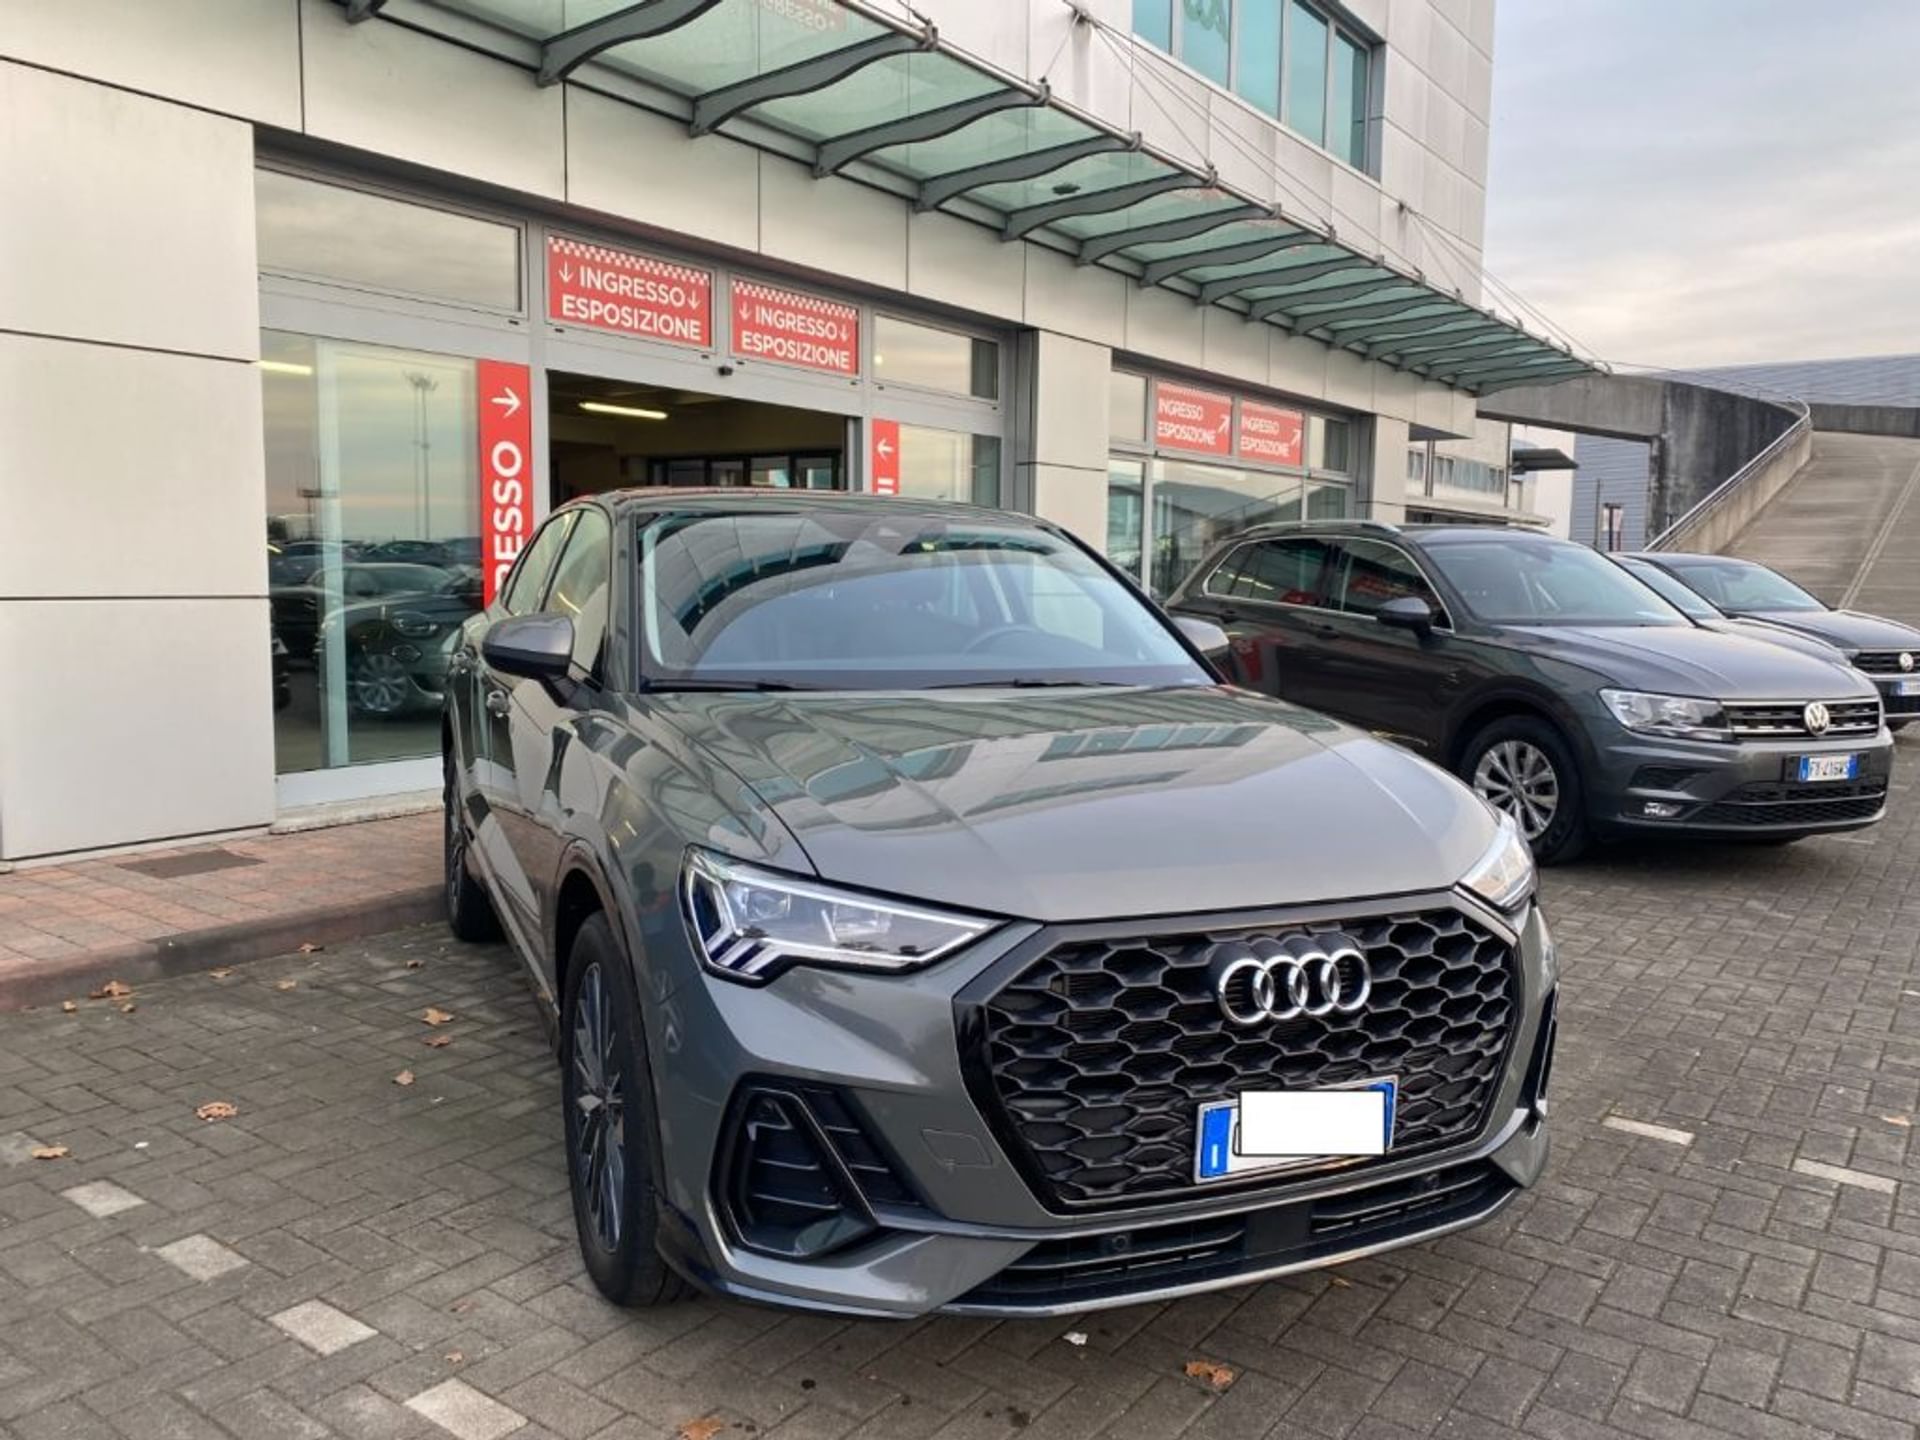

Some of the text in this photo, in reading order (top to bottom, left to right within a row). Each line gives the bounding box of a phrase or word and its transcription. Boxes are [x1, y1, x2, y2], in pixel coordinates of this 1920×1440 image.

[580, 266, 686, 307] INGRESSO
[562, 294, 701, 340] ESPOSIZIONE
[756, 305, 838, 340] INGRESSO
[742, 330, 850, 369] ESPOSIZIONE
[1158, 398, 1204, 421] INGRESSO
[1157, 421, 1217, 446] ESPOSIZIONE
[1241, 415, 1280, 436] INGRESSO
[1240, 436, 1290, 457] ESPOSIZIONE
